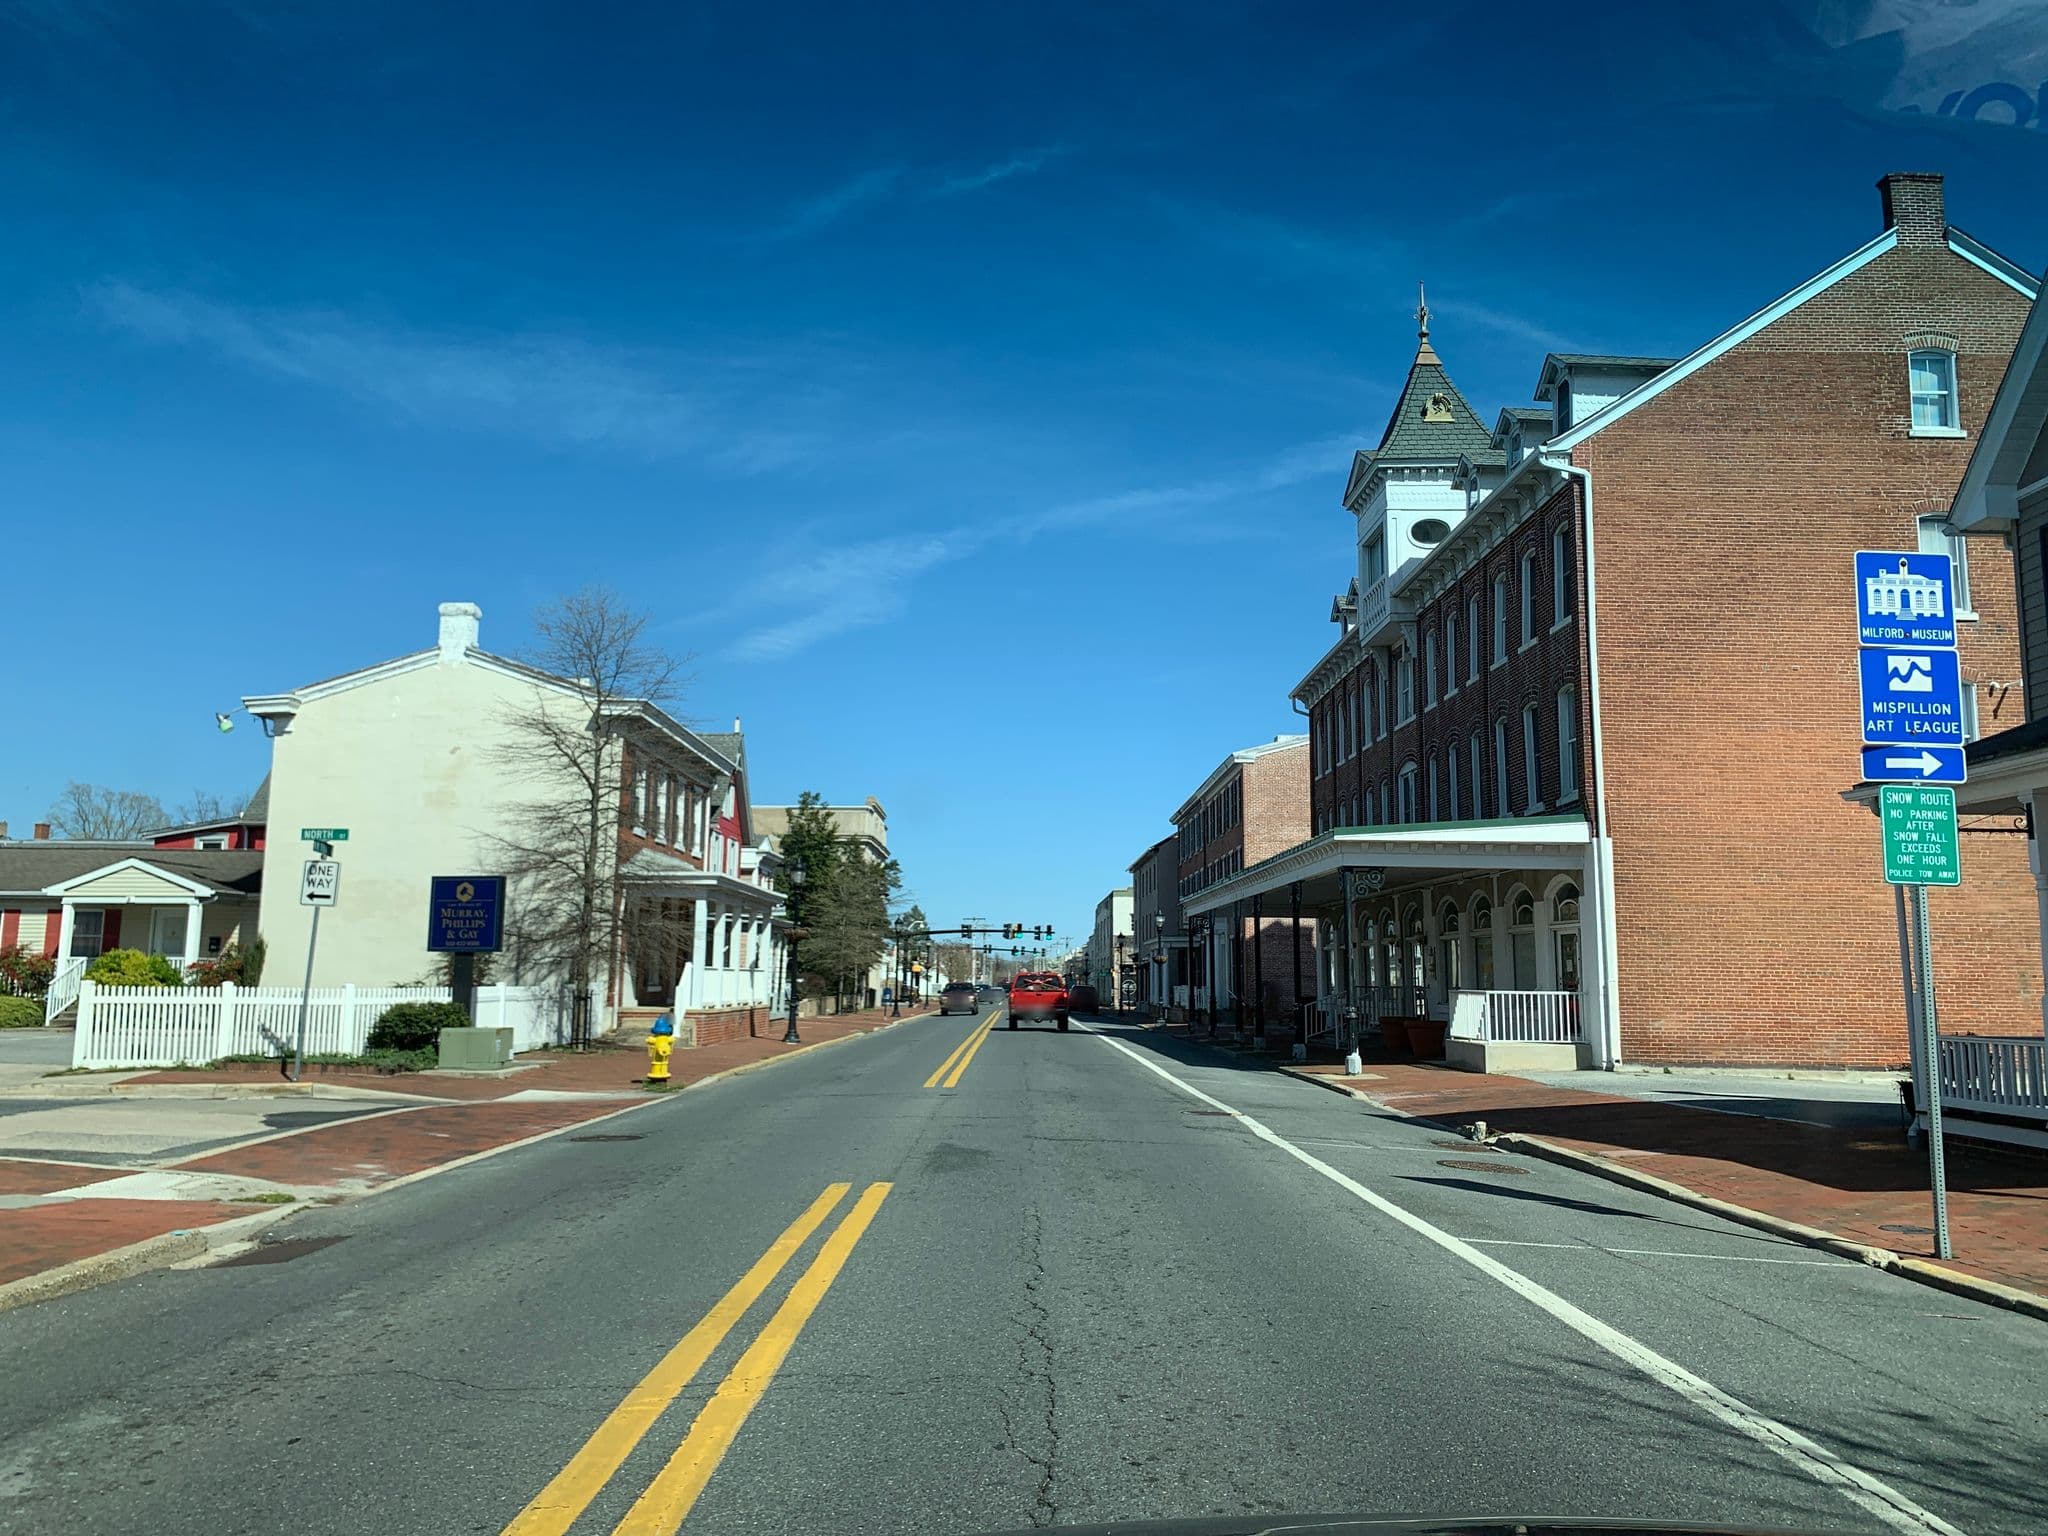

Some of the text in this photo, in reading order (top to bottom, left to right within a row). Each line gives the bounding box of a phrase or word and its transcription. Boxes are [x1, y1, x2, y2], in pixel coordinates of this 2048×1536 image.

[1862, 627, 1953, 641] MILFORD MUSEUM
[1872, 702, 1951, 715] MISPILLION
[1866, 720, 1960, 734] ART LEAGUE
[1886, 792, 1951, 806] SNOW ROUTE
[1890, 809, 1948, 820] NO PARKING
[1906, 821, 1934, 831] AFTER
[304, 830, 334, 839] NORTH
[1893, 832, 1948, 843] SNOW FALL
[1901, 843, 1941, 853] EXCEEDS
[1897, 855, 1947, 866] ONE HOUR
[309, 864, 334, 876] ONE
[1889, 869, 1913, 877] POLICE
[1919, 870, 1933, 878] TOW
[306, 878, 333, 888] WAY
[442, 918, 486, 928] PHILLIPS
[446, 929, 478, 939] & GAY
